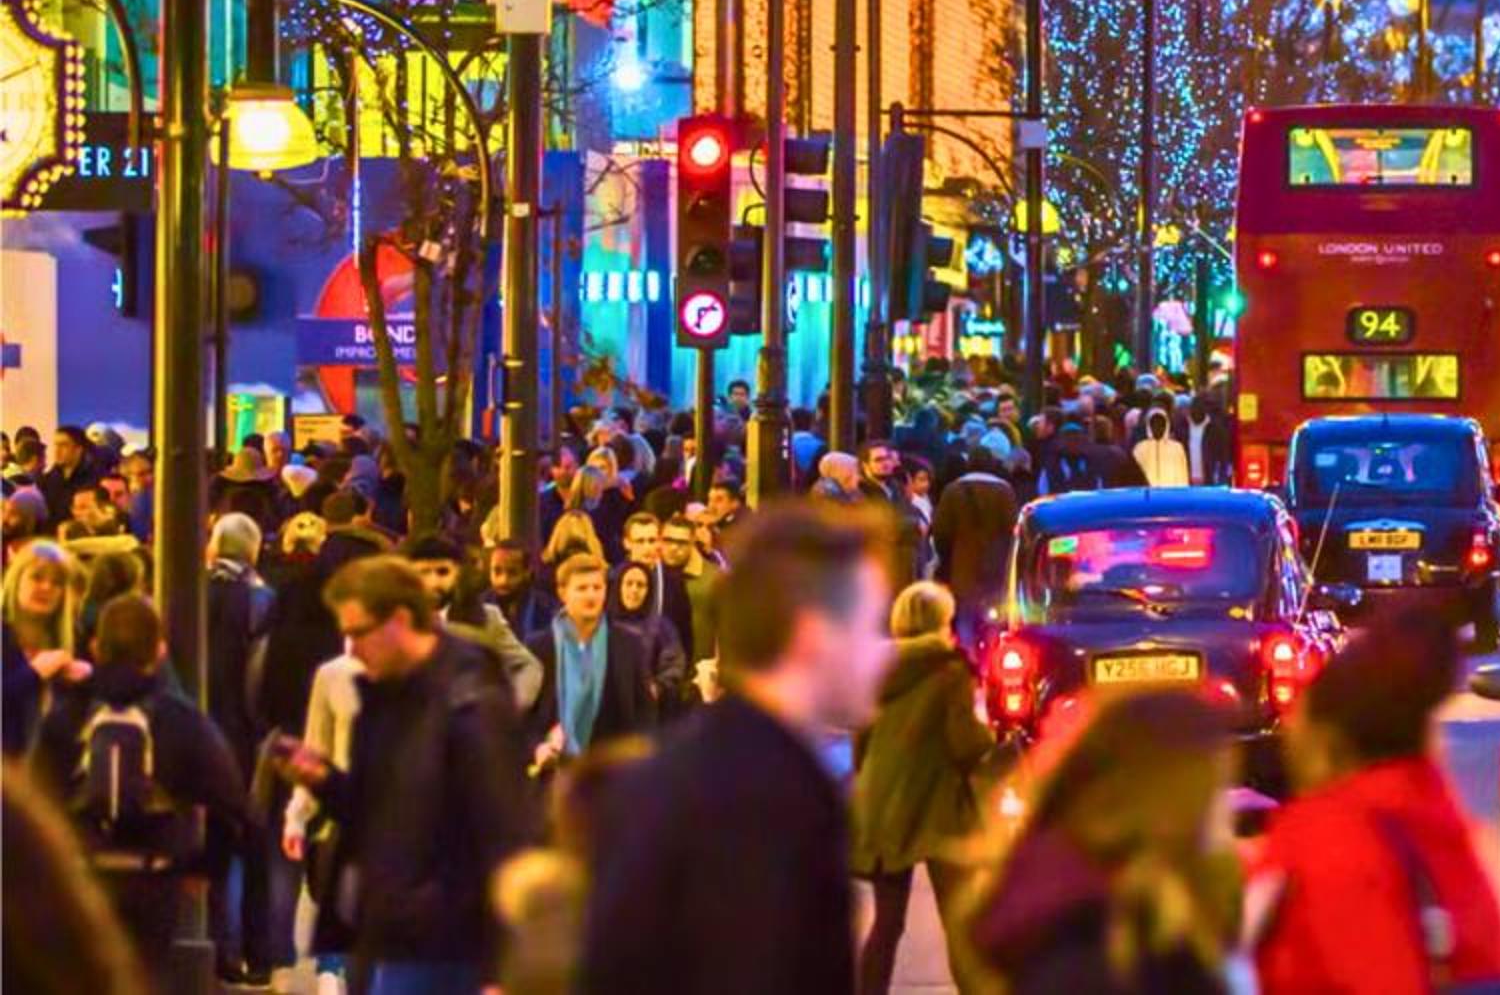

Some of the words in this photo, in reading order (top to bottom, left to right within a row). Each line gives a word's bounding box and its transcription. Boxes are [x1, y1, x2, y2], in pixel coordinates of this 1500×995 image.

[123, 146, 149, 177] 21
[1317, 242, 1378, 254] LONDON
[1384, 243, 1444, 254] UNITED
[1360, 310, 1401, 338] 94
